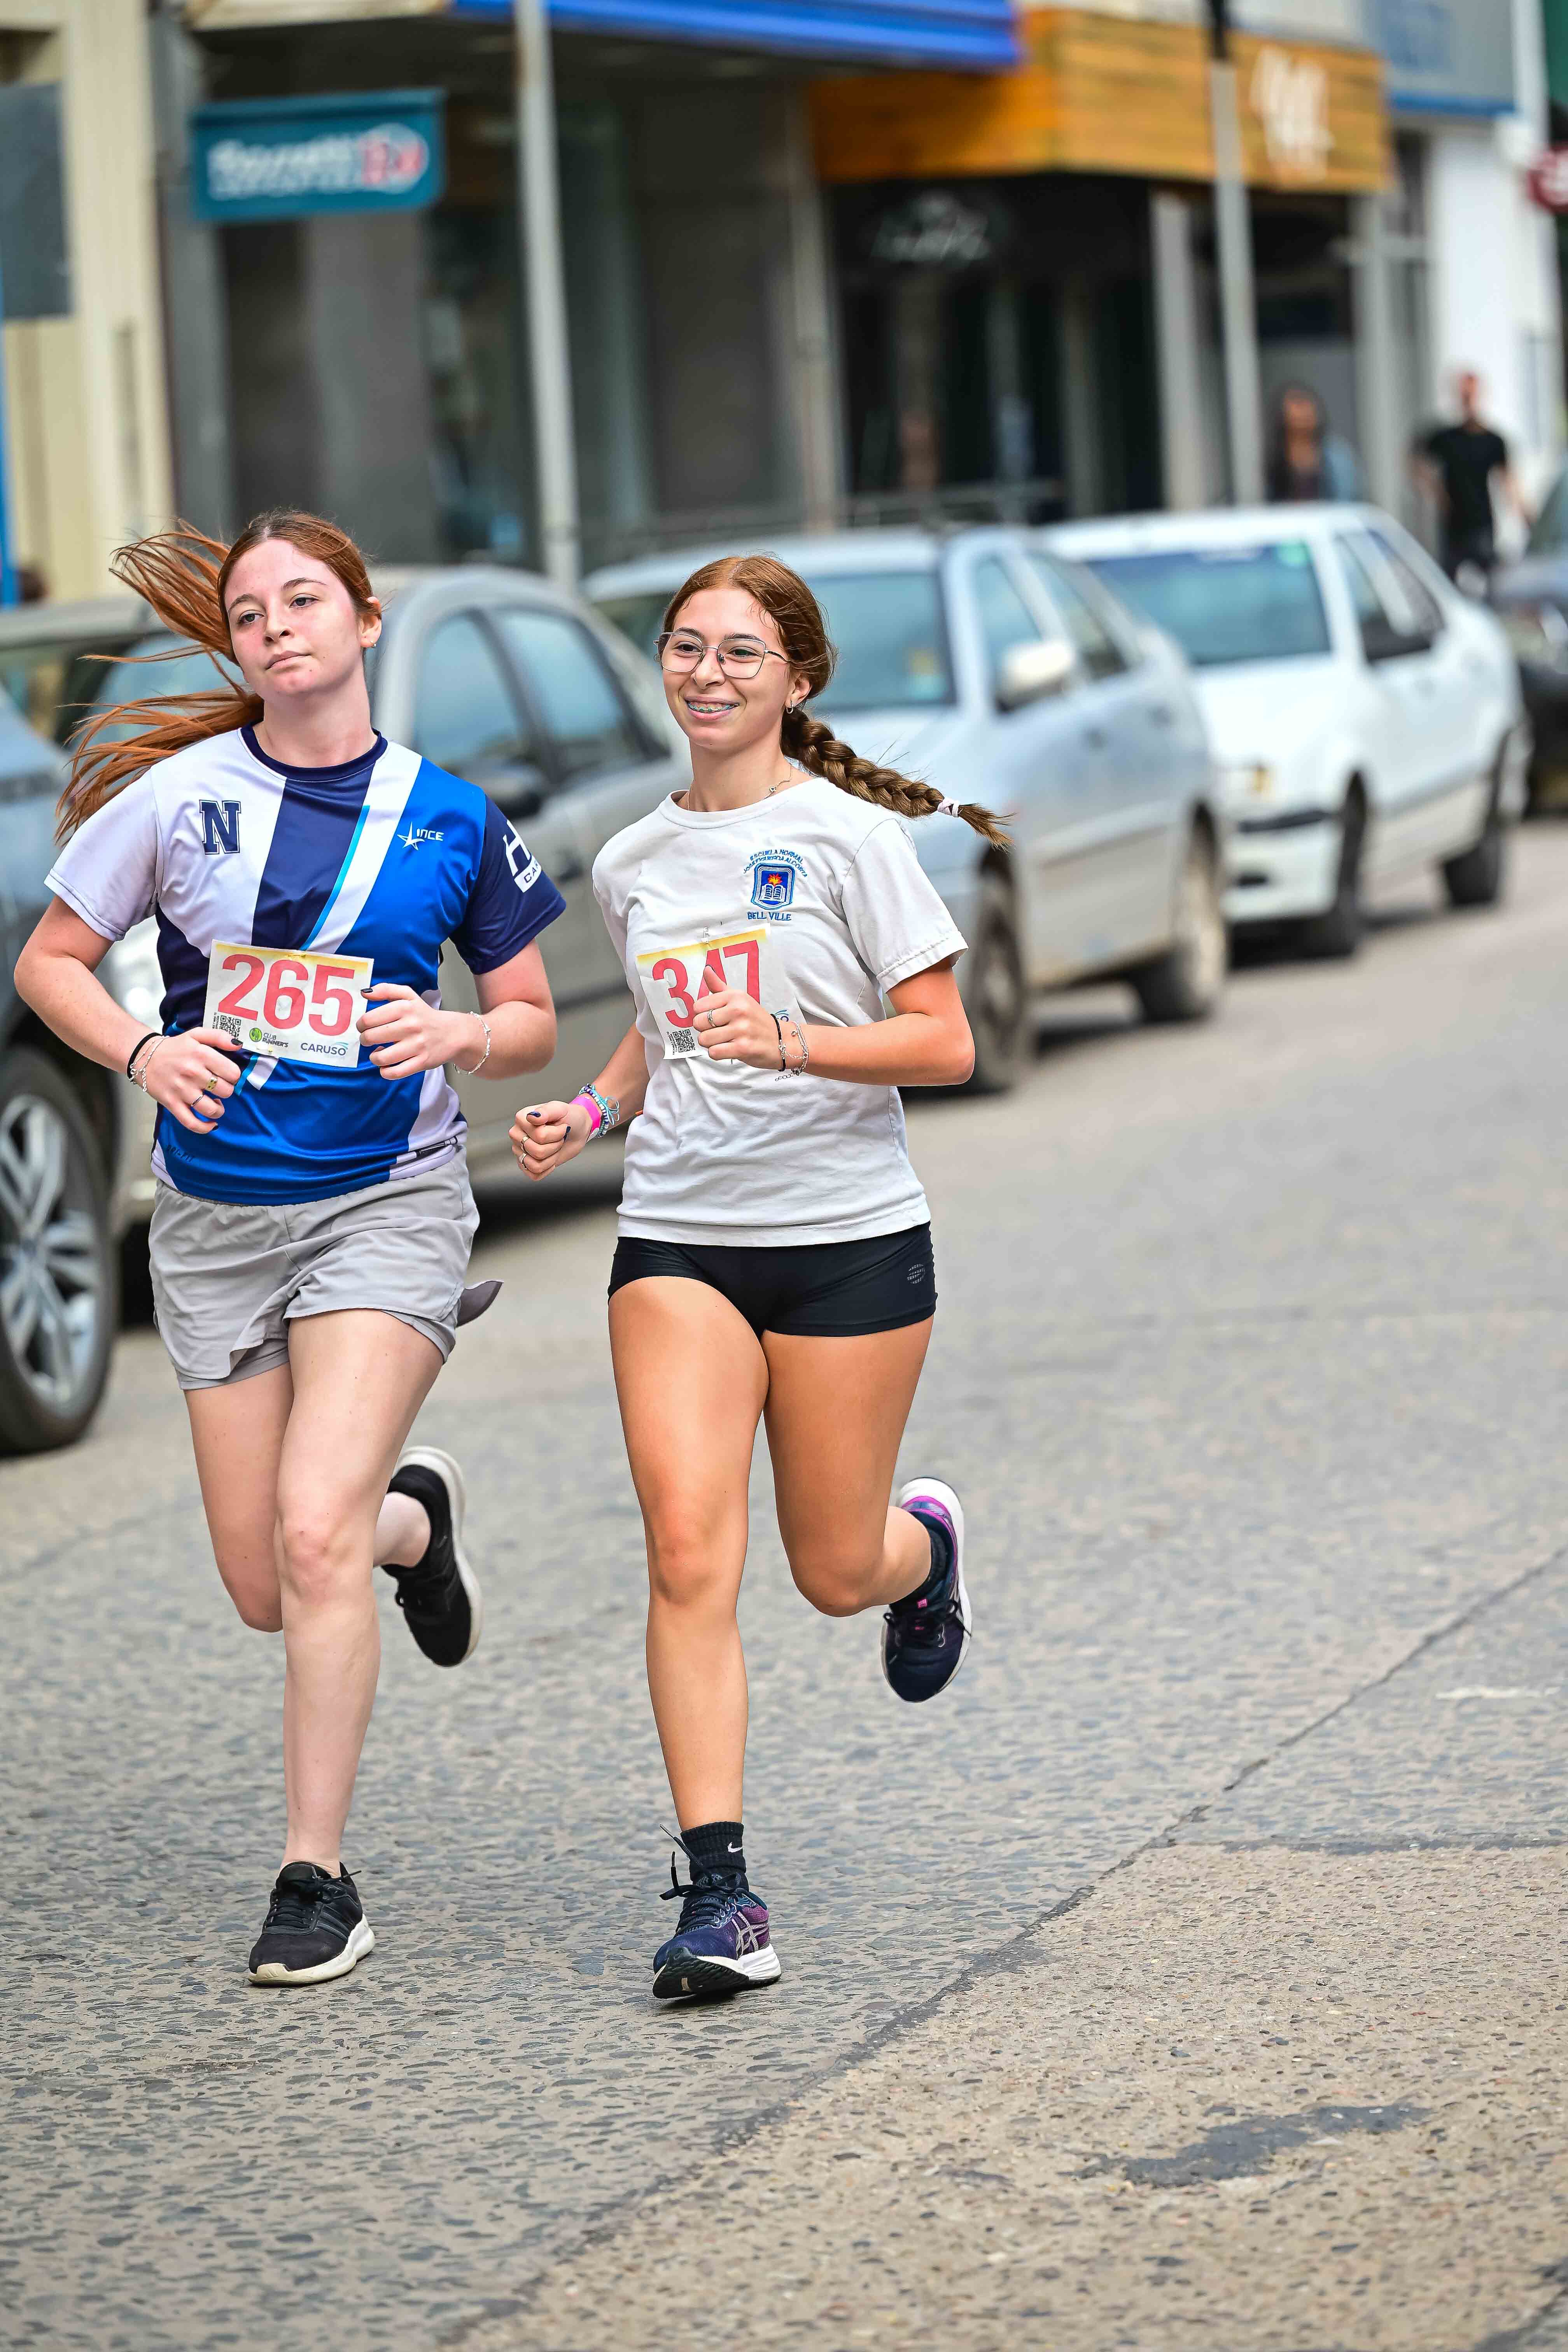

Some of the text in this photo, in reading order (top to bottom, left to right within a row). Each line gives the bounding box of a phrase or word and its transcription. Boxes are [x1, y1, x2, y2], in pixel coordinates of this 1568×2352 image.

[199, 799, 241, 855] N
[779, 849, 803, 864] NORMAL
[747, 912, 792, 921] BELL VILLE
[218, 954, 355, 1036] 265
[262, 1037, 289, 1048] RUNNER'S
[301, 1043, 346, 1056] CARUSO
